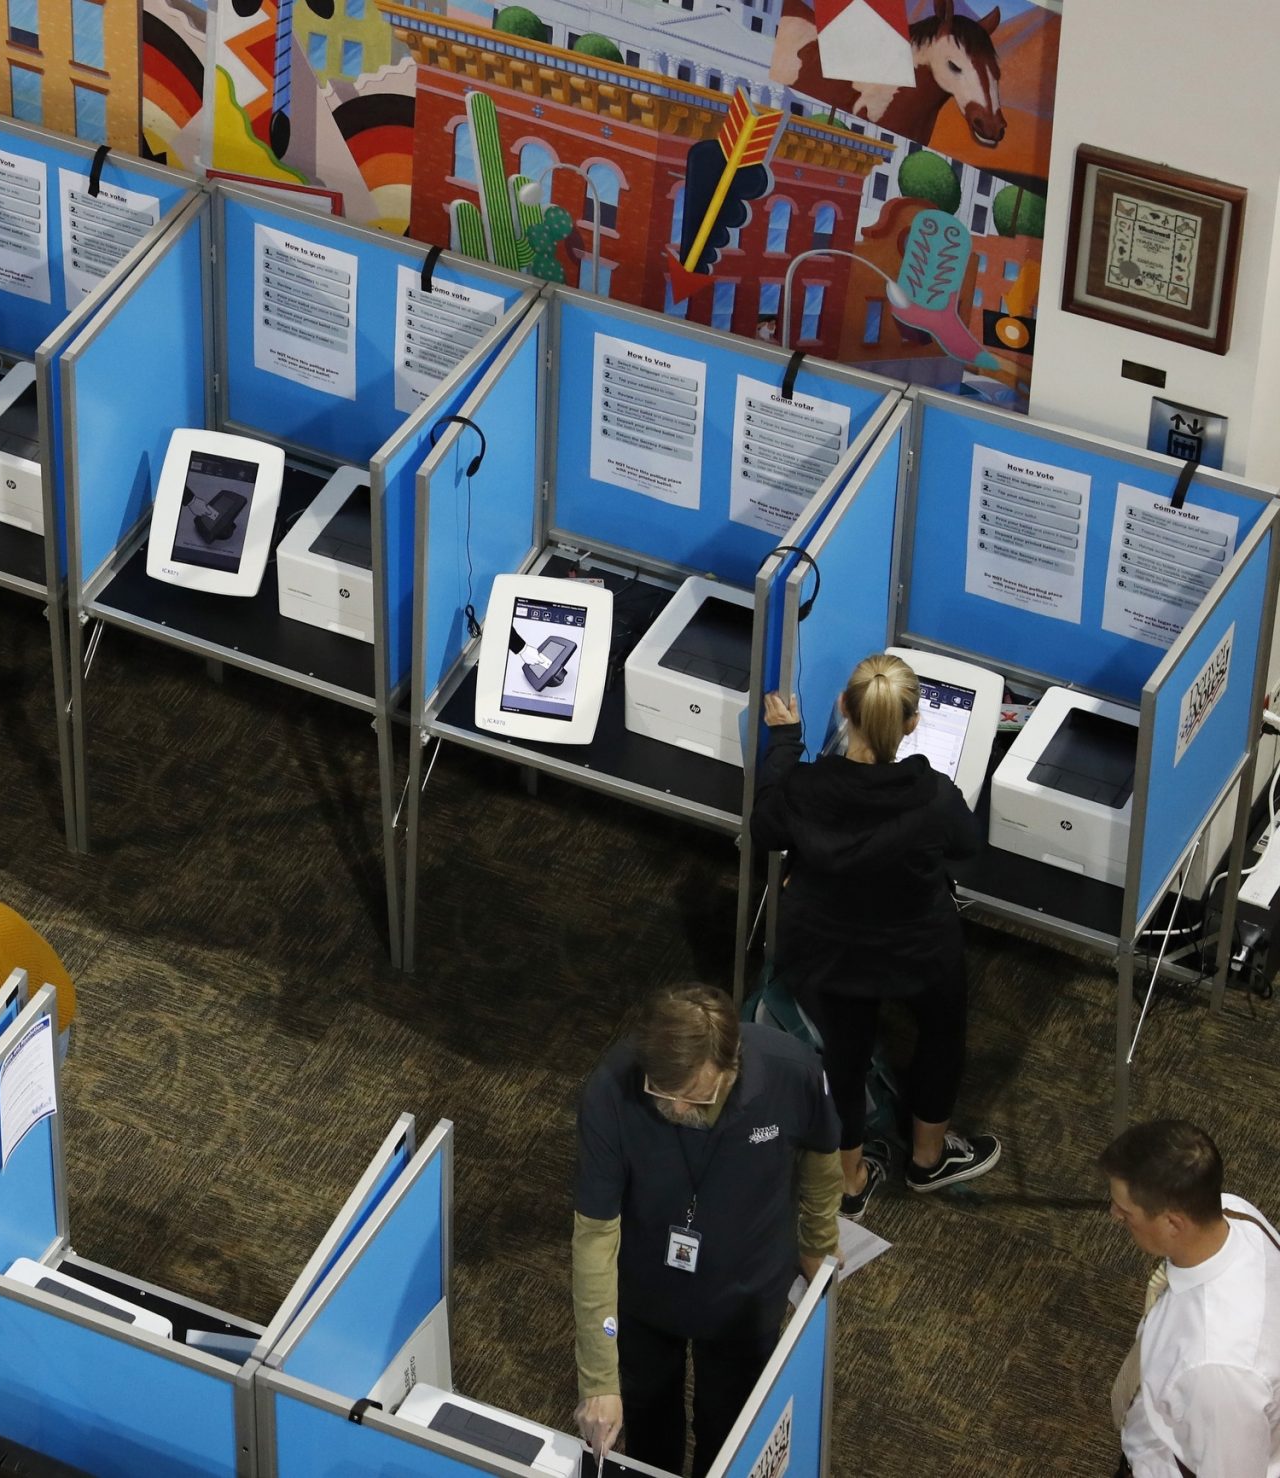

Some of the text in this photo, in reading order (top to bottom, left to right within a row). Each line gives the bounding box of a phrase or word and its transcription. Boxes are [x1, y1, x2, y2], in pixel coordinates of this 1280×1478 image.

[0, 158, 14, 168] Vote
[285, 241, 298, 252] How
[309, 250, 325, 261] Vote
[451, 291, 470, 302] votar
[408, 305, 415, 313] 2.
[408, 319, 415, 327] 3.
[407, 333, 414, 341] 4.
[605, 357, 613, 365] 1.
[627, 350, 670, 369] How to Vote
[405, 360, 413, 368] 6.
[604, 371, 612, 379] 2.
[604, 386, 611, 394] 3.
[603, 400, 611, 408] 4.
[794, 399, 814, 411] votar
[602, 414, 610, 422] 5.
[746, 415, 755, 423] 2.
[602, 428, 610, 436] 6.
[746, 430, 754, 438] 3.
[744, 457, 752, 465] 5.
[743, 470, 751, 479] 6.
[984, 469, 992, 478] 1.
[1007, 462, 1054, 481] How to Vote
[982, 483, 991, 492] 2.
[982, 498, 990, 507] 3.
[980, 512, 989, 521] 4.
[1128, 509, 1137, 517] 1.
[1178, 510, 1200, 521] votar
[1126, 523, 1135, 531] 2.
[980, 527, 988, 536] 5.
[979, 541, 987, 550] 6.
[1124, 538, 1133, 546] 3.
[1122, 552, 1131, 560] 4.
[1120, 566, 1129, 575] 5.
[1119, 580, 1127, 588] 6.
[339, 588, 350, 598] hp
[690, 704, 701, 714] hp
[1060, 820, 1072, 830] hp
